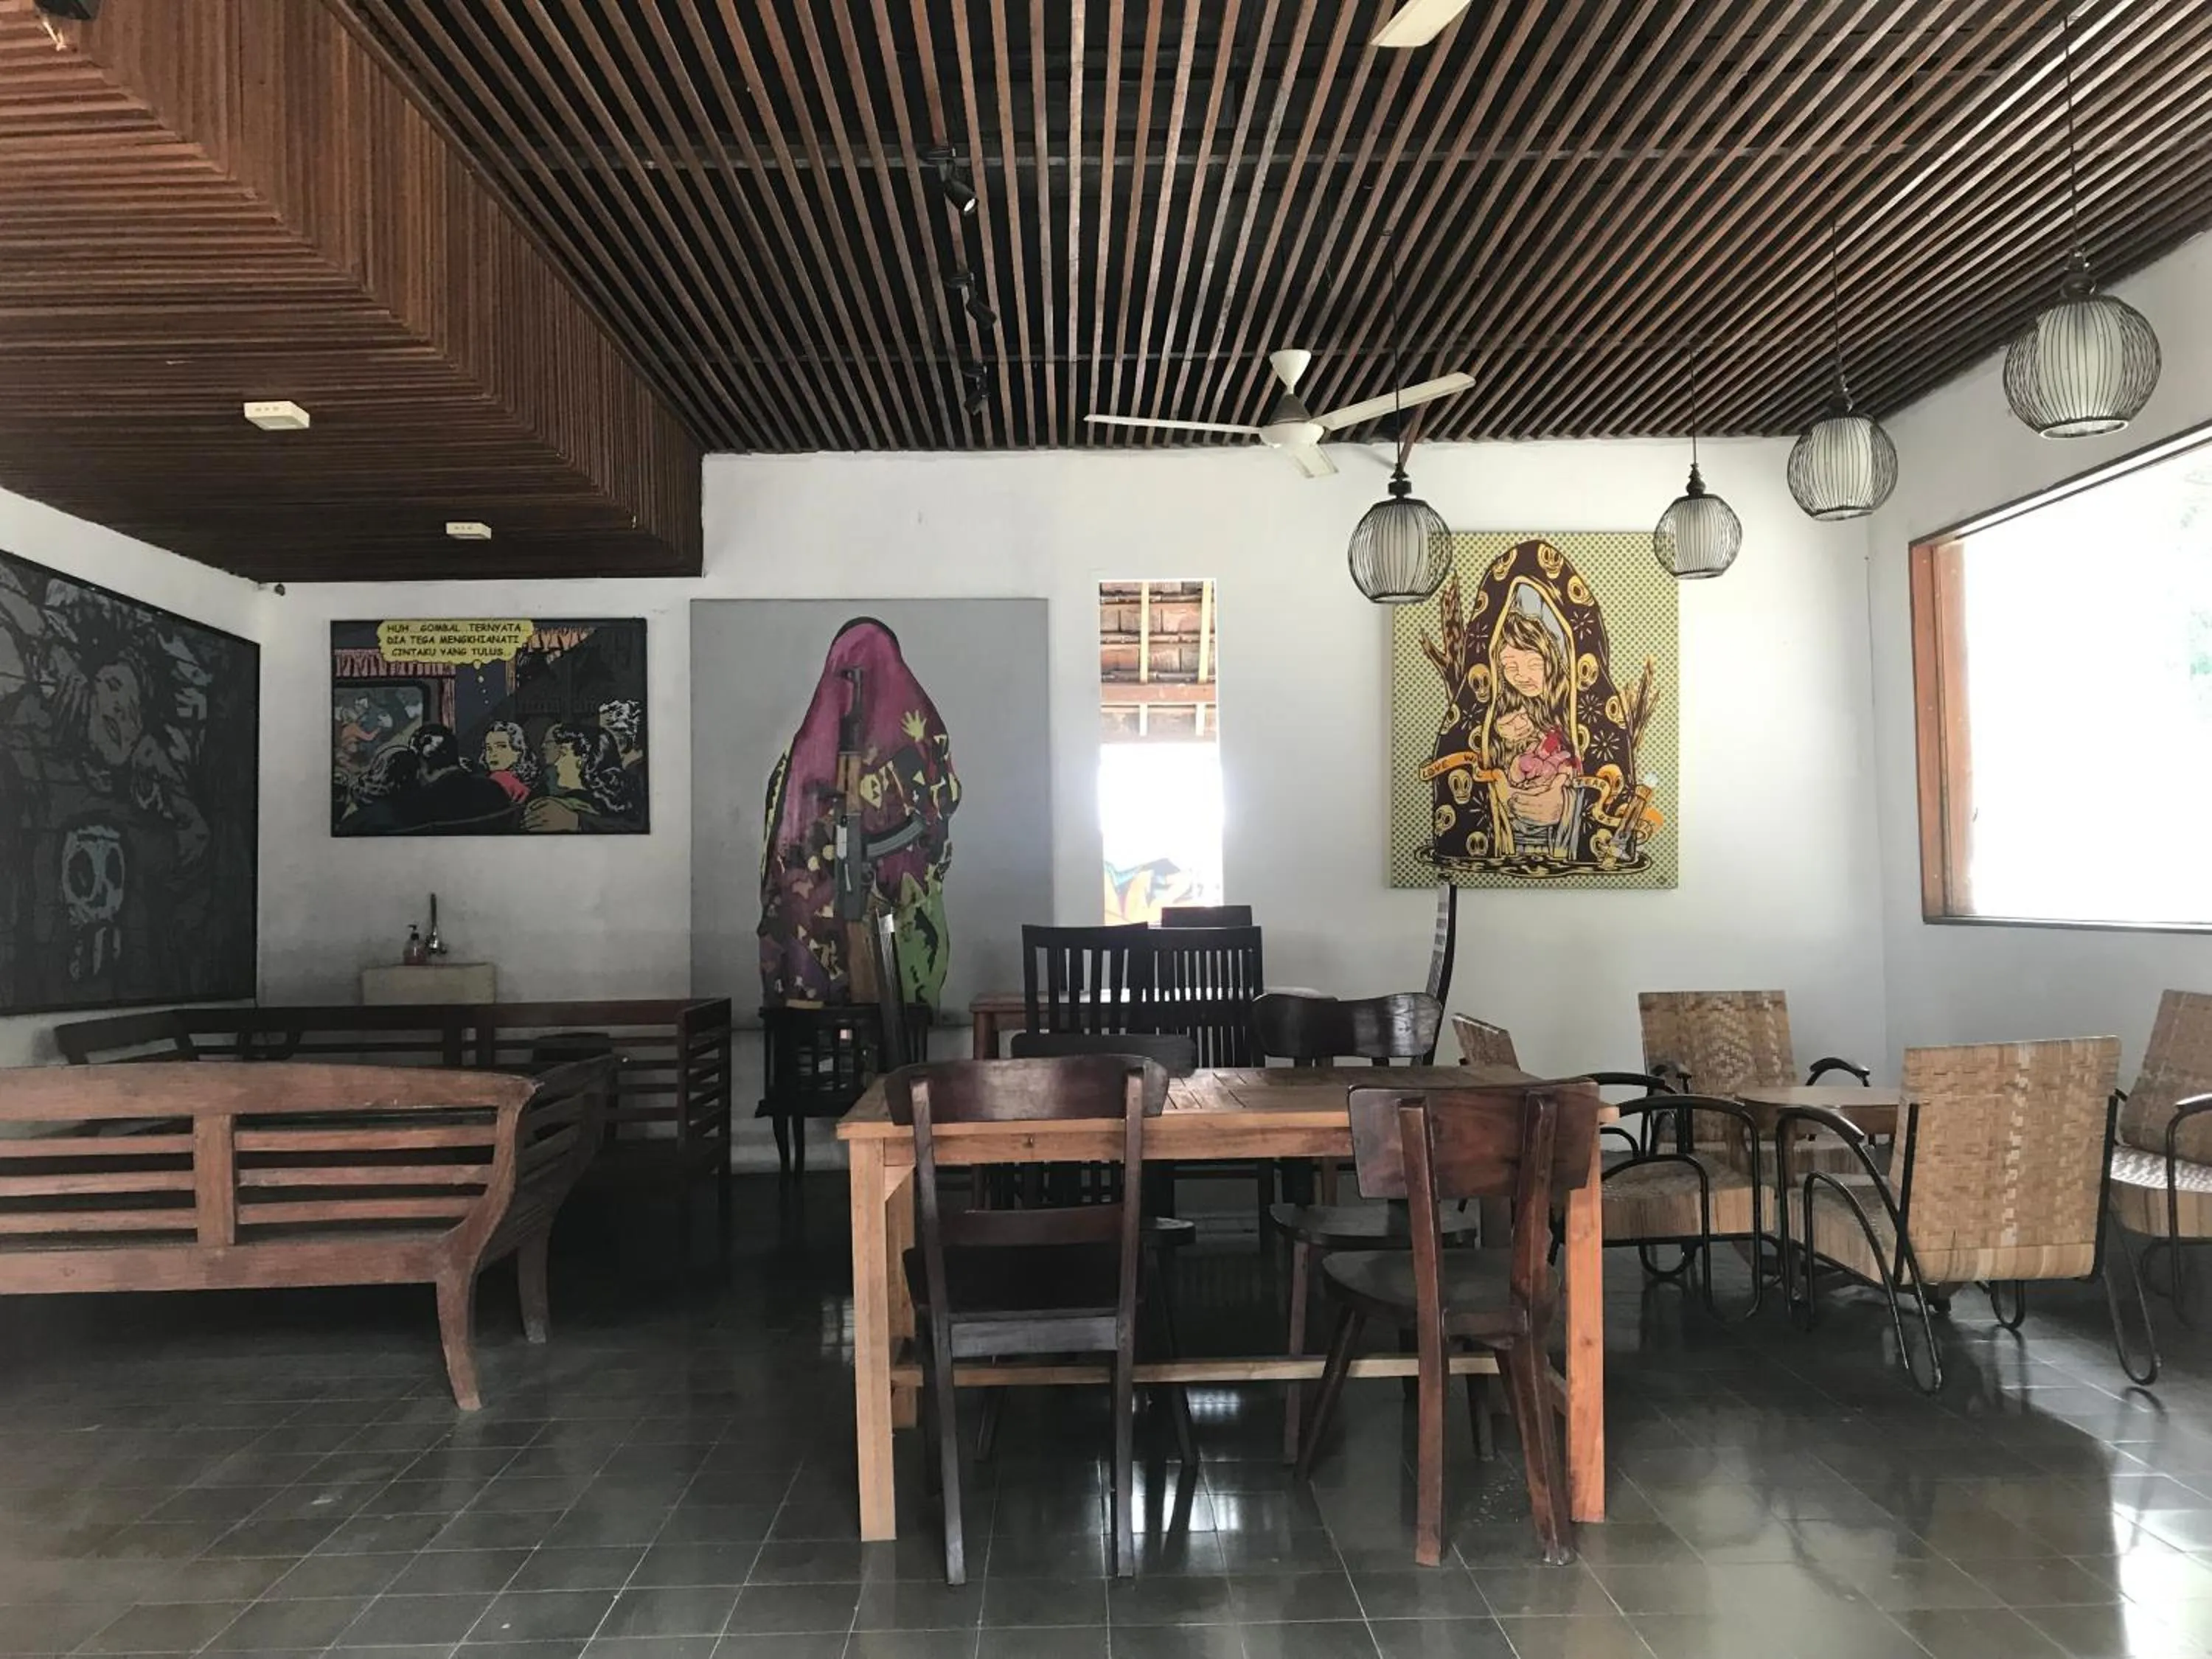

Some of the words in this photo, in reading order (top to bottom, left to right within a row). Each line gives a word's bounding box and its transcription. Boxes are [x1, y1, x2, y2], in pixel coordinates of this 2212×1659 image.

[386, 635, 406, 644] DIA
[410, 635, 434, 644] TEGA
[439, 635, 519, 644] MENGKHIANATI
[391, 647, 437, 656] CINTAKU
[439, 647, 467, 656] YANG
